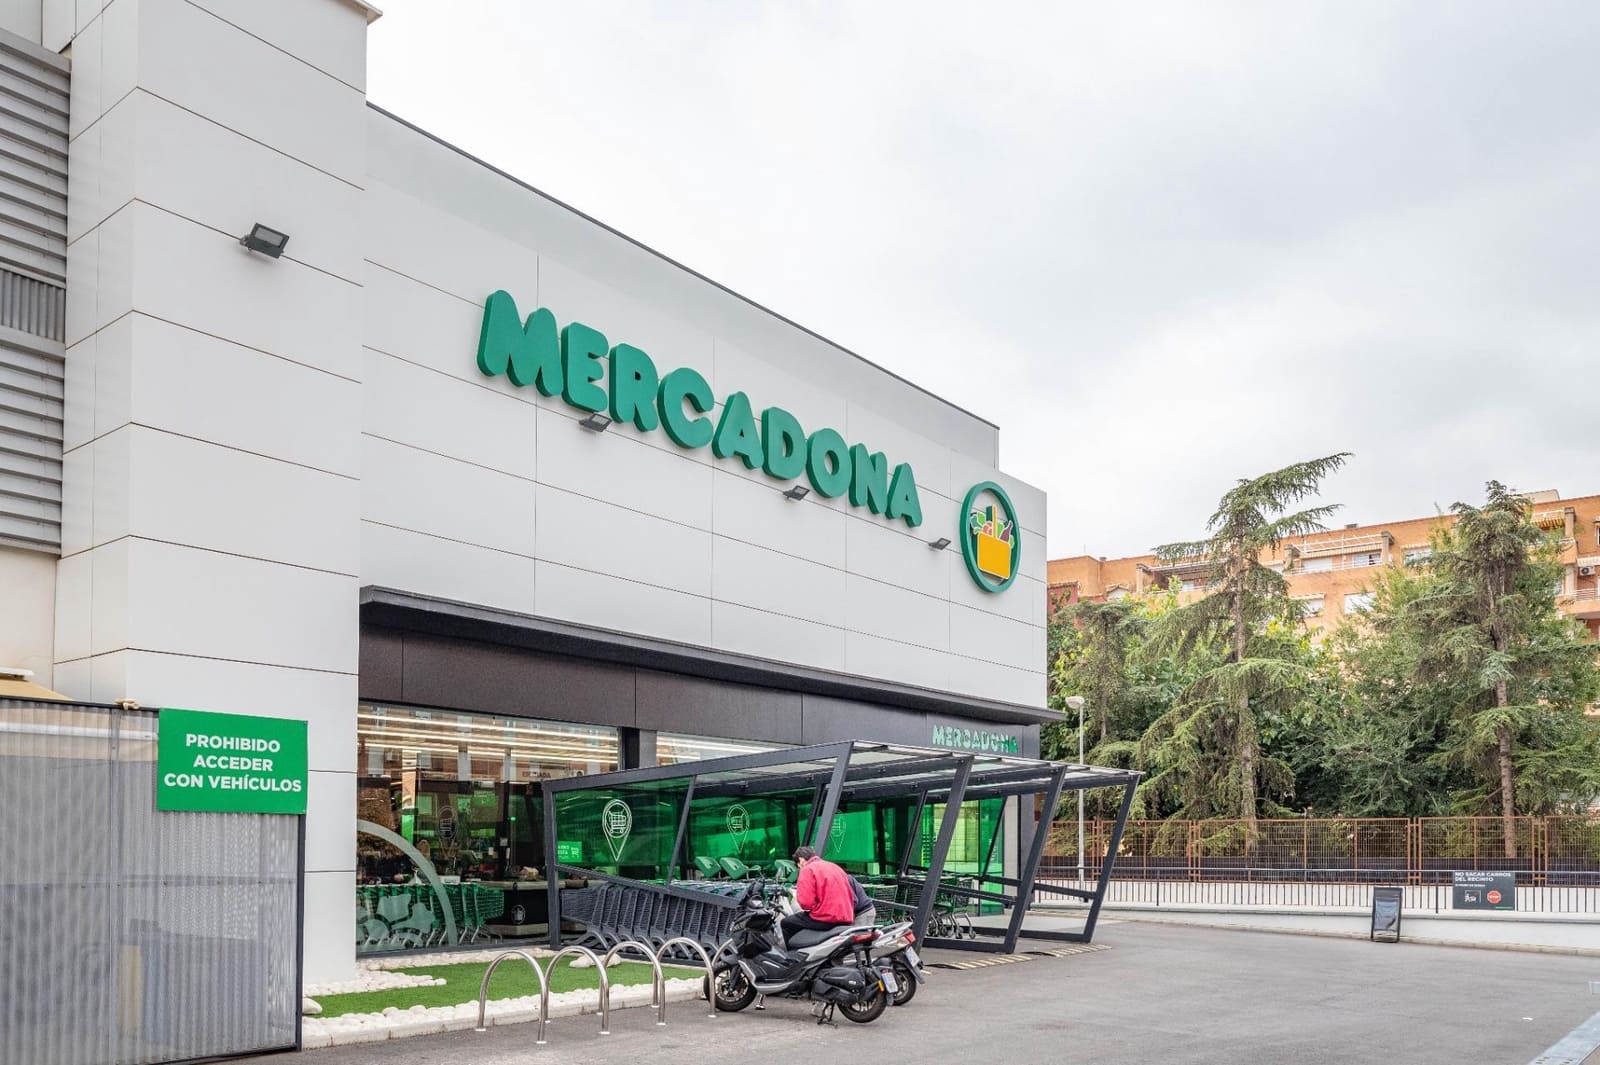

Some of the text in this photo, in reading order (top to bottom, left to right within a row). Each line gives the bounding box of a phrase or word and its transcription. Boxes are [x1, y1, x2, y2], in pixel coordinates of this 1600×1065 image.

[477, 290, 922, 528] MERCADONA
[186, 733, 281, 753] PROHIBIDO
[932, 724, 1019, 753] MERCADONA
[193, 755, 273, 772] ACCEDER
[164, 773, 302, 792] CON VEHÍCULOS
